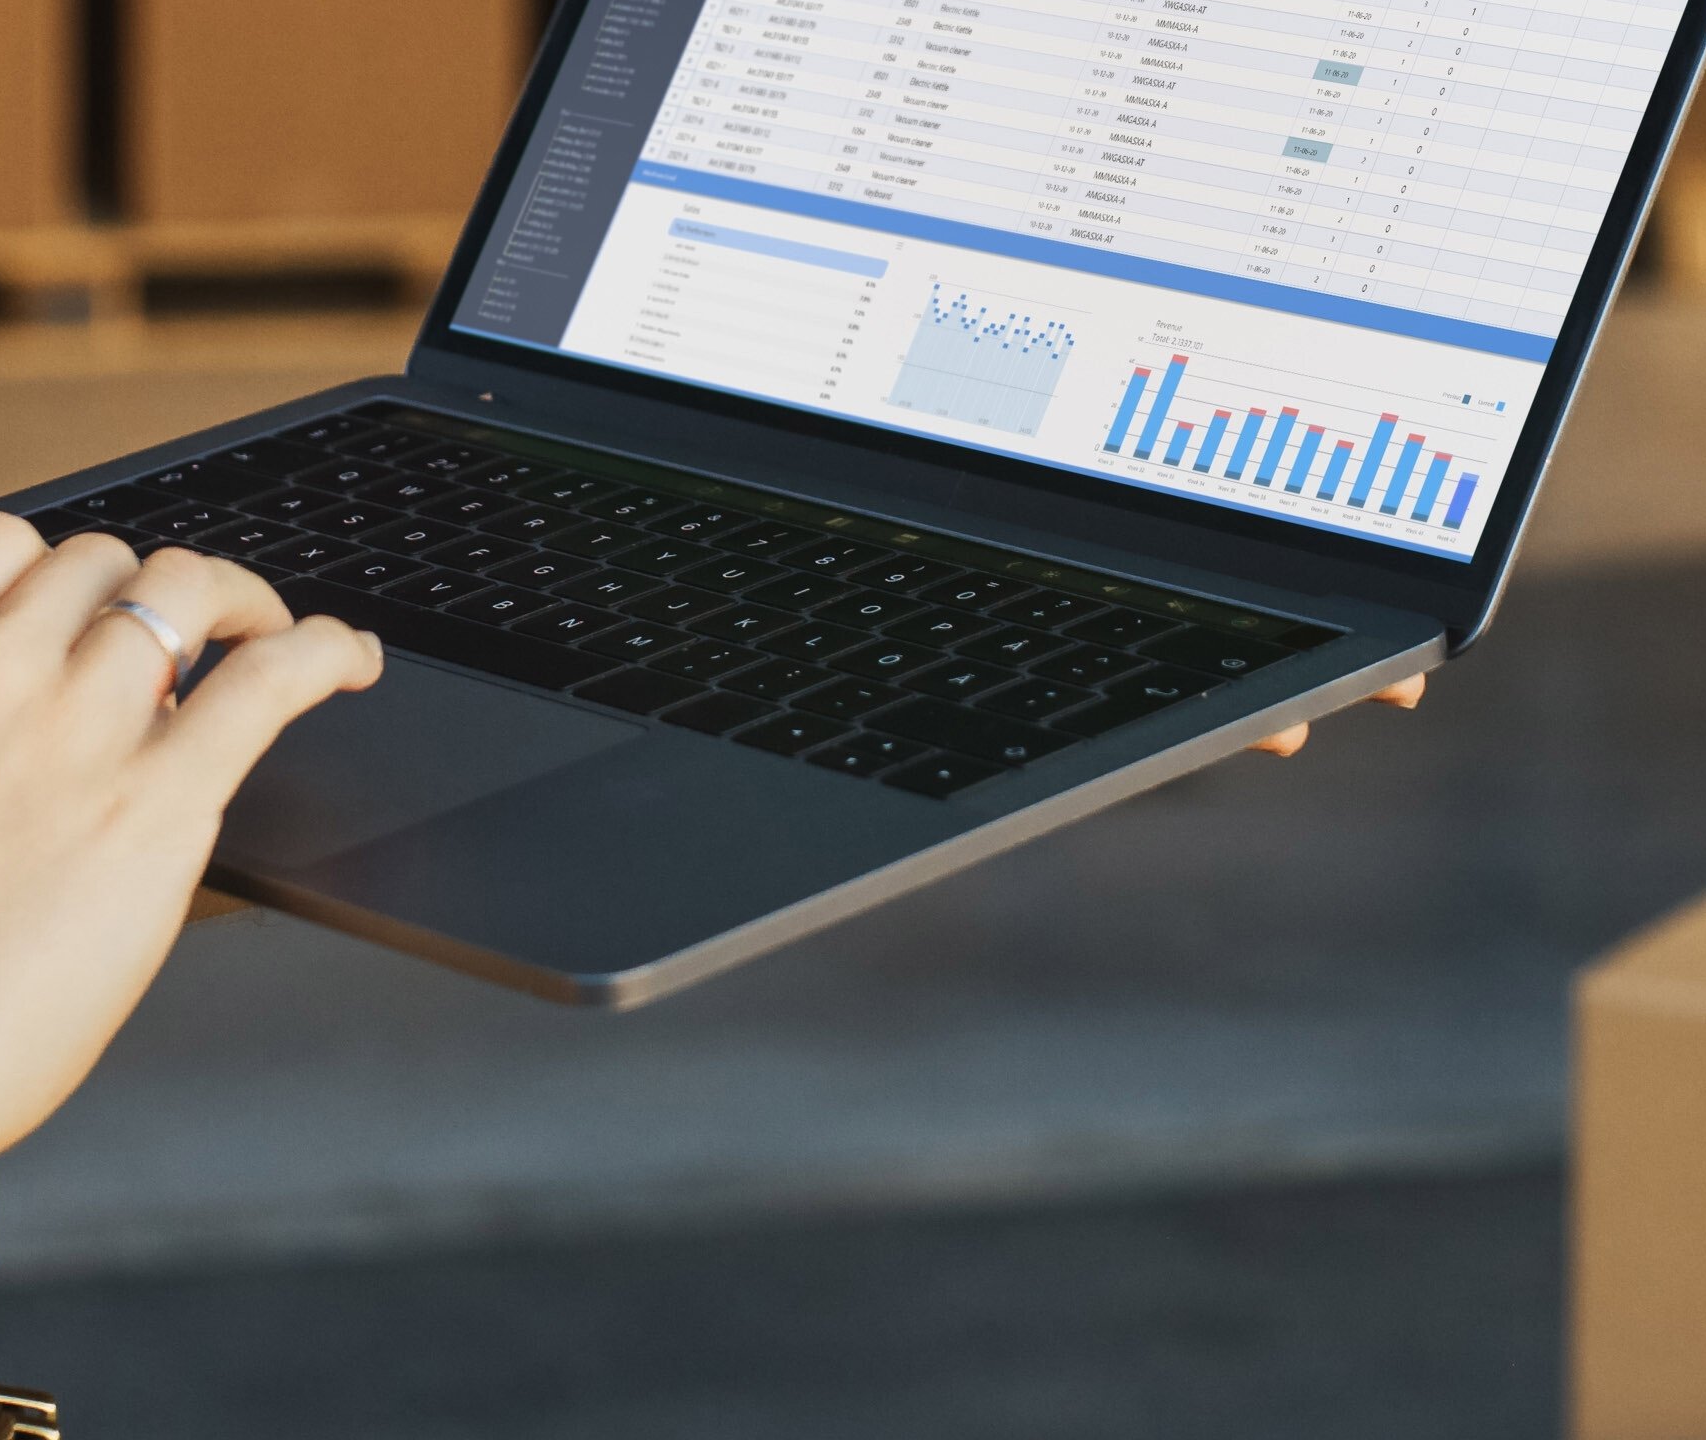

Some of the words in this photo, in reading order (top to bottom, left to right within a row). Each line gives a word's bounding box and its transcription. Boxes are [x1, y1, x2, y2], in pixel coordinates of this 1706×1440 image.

[1162, 0, 1208, 14] XWGASXA-AT
[940, 3, 962, 15] Electric
[962, 8, 980, 18] Kettle
[1147, 38, 1188, 52] AMGASXA-A
[1156, 19, 1199, 33] MMMASXA-A
[933, 21, 955, 32] Electric
[955, 25, 973, 35] Kettle
[1141, 57, 1183, 71] MMMASXA-A
[949, 47, 972, 56] cleaner
[917, 60, 939, 71] Electric
[938, 64, 956, 74] Kettle
[909, 77, 932, 89] Electric
[932, 82, 949, 92] Kettle
[927, 100, 949, 110] cleaner
[919, 120, 941, 130] cleaner
[1101, 152, 1145, 167] XWGASXA-AT
[911, 139, 933, 148] cleaner
[1093, 171, 1136, 186] MMMASXA-A
[903, 157, 925, 167] cleaner
[1085, 190, 1126, 205] AMGASXA-A
[895, 177, 917, 186] cleaner
[1078, 209, 1121, 224] MMMASXA-A
[864, 188, 893, 201] Keyboard
[1070, 228, 1114, 244] XWGASXA-AT
[1156, 319, 1183, 332] Revenue
[339, 471, 359, 481] Q
[489, 474, 508, 482] 3
[398, 485, 424, 495] W
[282, 500, 301, 508] A
[461, 502, 483, 511] E
[615, 506, 636, 514] 5
[343, 515, 364, 524] S
[524, 519, 545, 527] R
[240, 532, 263, 541] Z
[404, 532, 426, 540] D
[591, 535, 611, 543] T
[300, 549, 324, 558] X
[657, 552, 676, 560] Y
[365, 566, 385, 575] C
[534, 566, 554, 574] G
[722, 569, 745, 578] U
[885, 574, 905, 582] 9
[430, 583, 451, 591] V
[598, 583, 622, 592] H
[956, 591, 976, 599] 0
[492, 600, 514, 609] B
[860, 605, 882, 614] O
[559, 618, 583, 628] N
[734, 618, 758, 628] K
[626, 636, 653, 646] M
[805, 636, 822, 646] L
